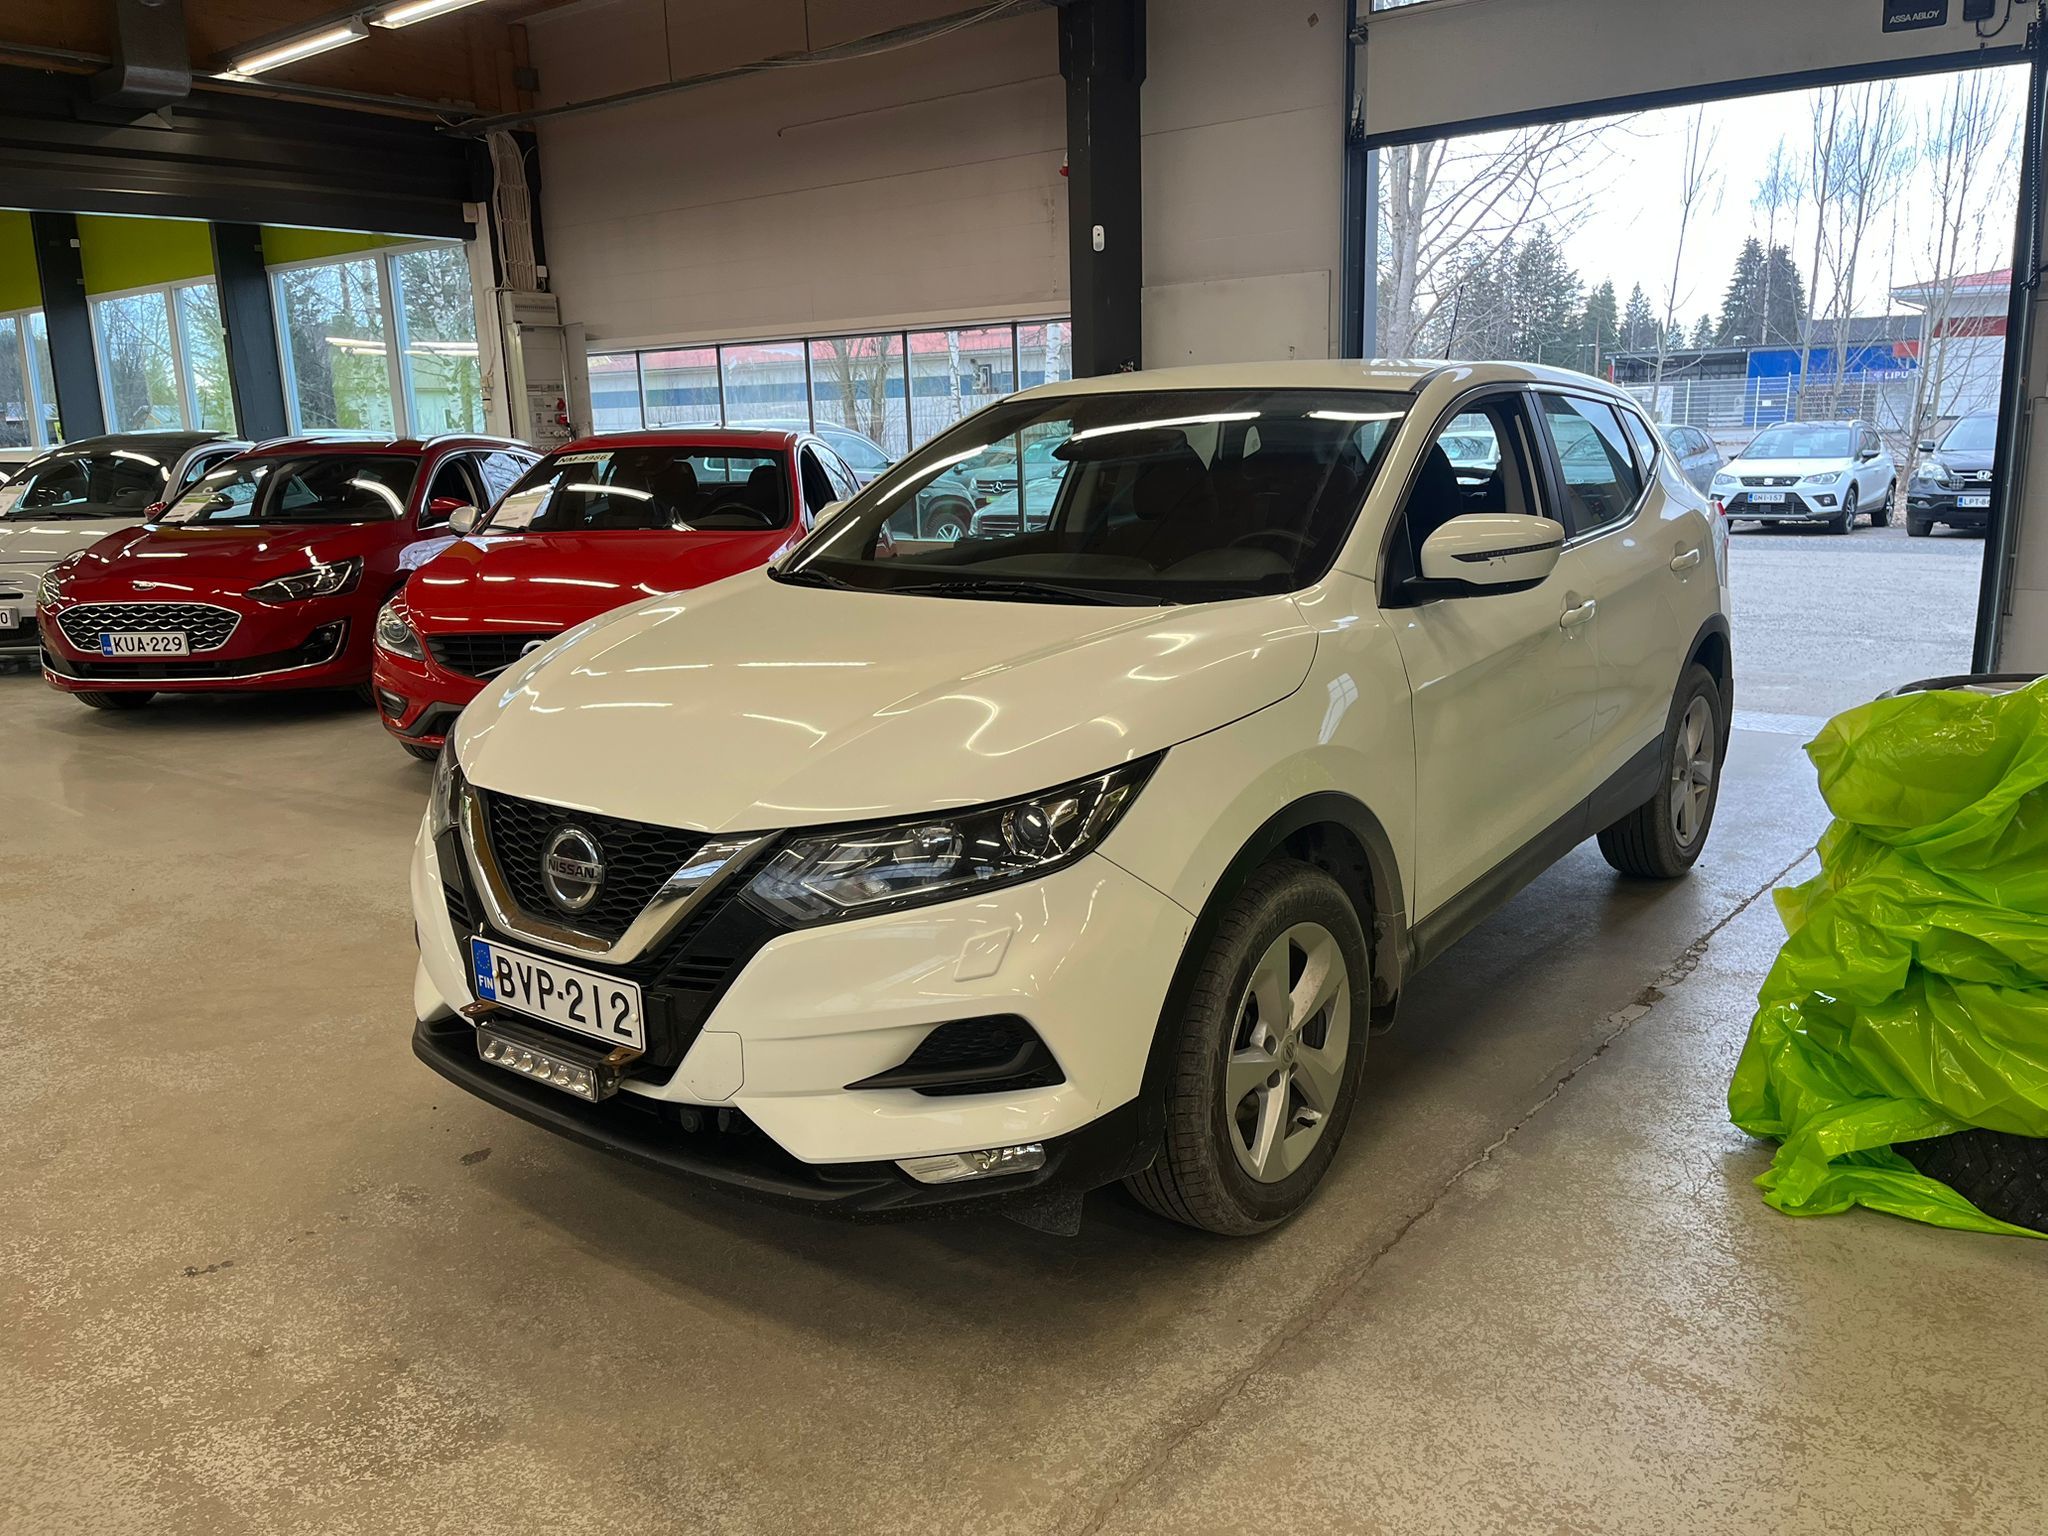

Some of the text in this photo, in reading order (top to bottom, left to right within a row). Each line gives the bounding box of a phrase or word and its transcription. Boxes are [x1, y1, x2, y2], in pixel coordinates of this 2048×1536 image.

[1889, 10, 1940, 24] ASSA ABLOY
[112, 636, 182, 652] KUA-229
[548, 858, 595, 879] NISSAN
[478, 975, 494, 990] FIN
[496, 955, 633, 1038] BVP-212
